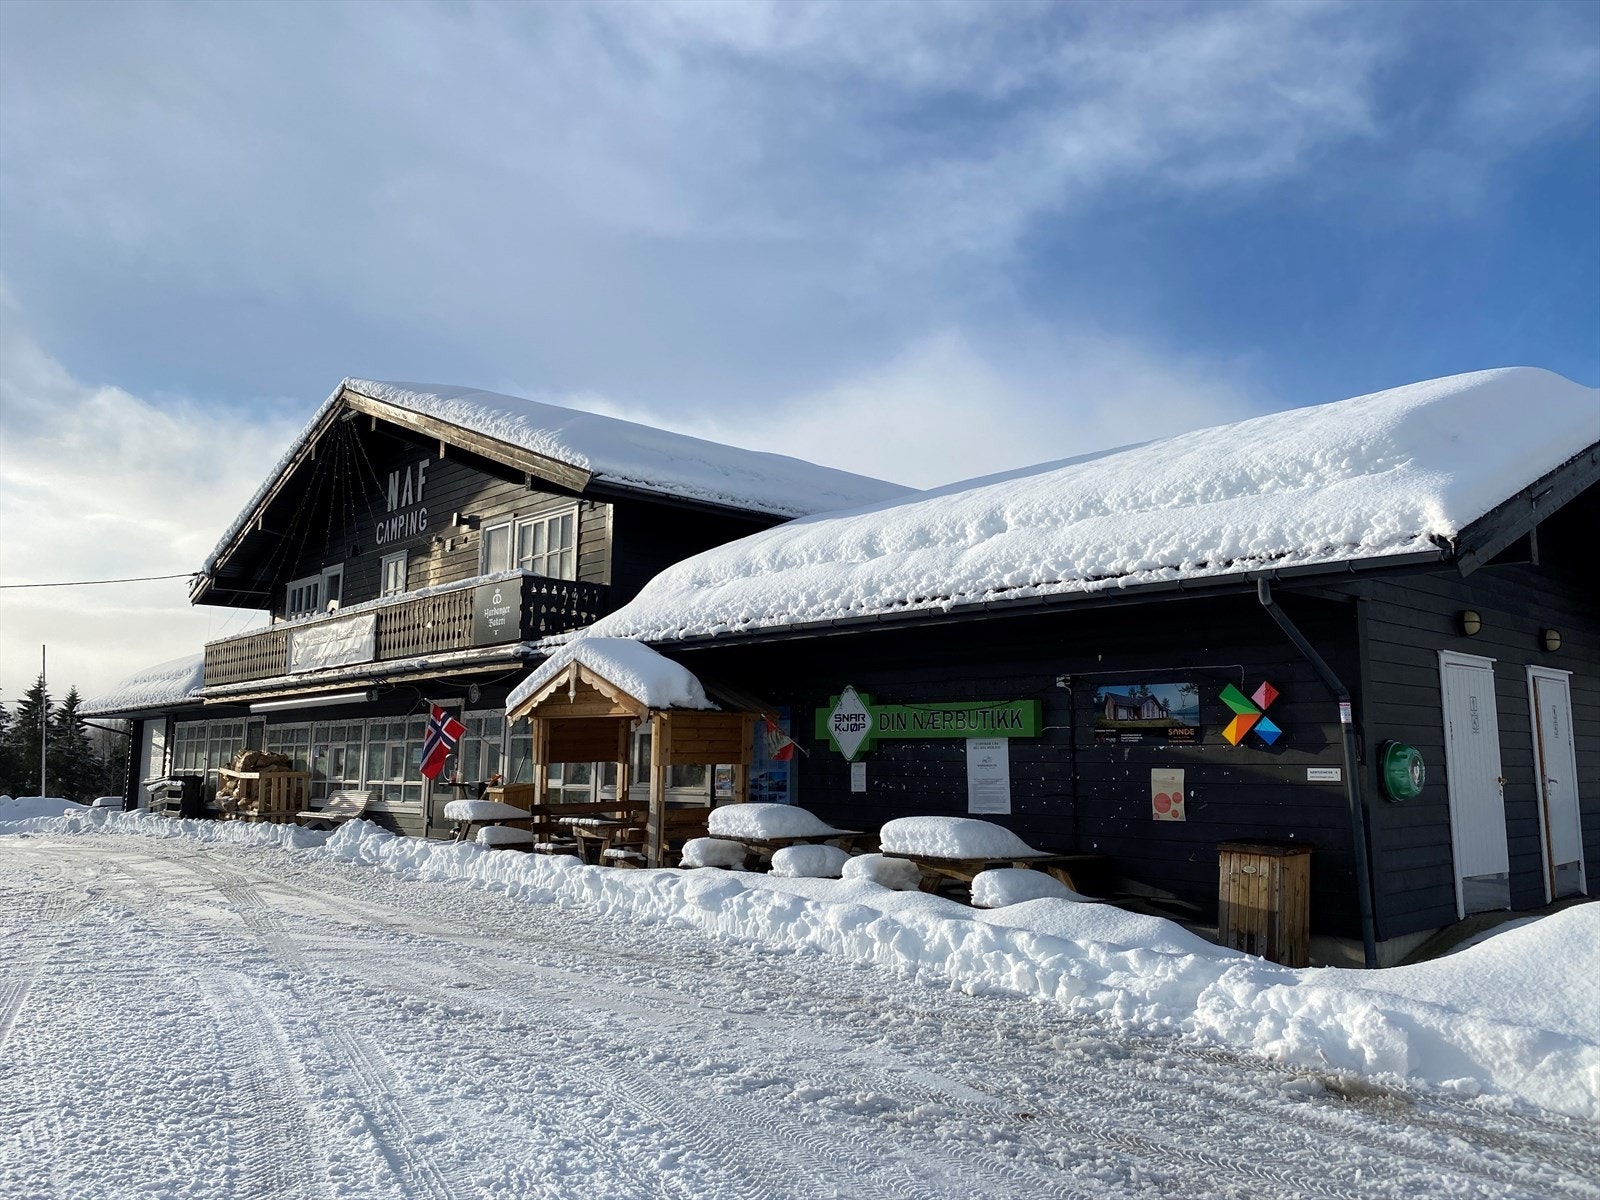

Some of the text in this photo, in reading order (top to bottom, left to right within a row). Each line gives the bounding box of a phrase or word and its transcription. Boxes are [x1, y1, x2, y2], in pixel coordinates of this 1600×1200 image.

[387, 458, 430, 513] NAF
[376, 507, 427, 545] CAMPING
[833, 713, 866, 722] SNAR
[879, 708, 1024, 731] DIN NÆRBUTIKK
[834, 722, 866, 733] KJØP
[1168, 728, 1195, 736] SANDE
